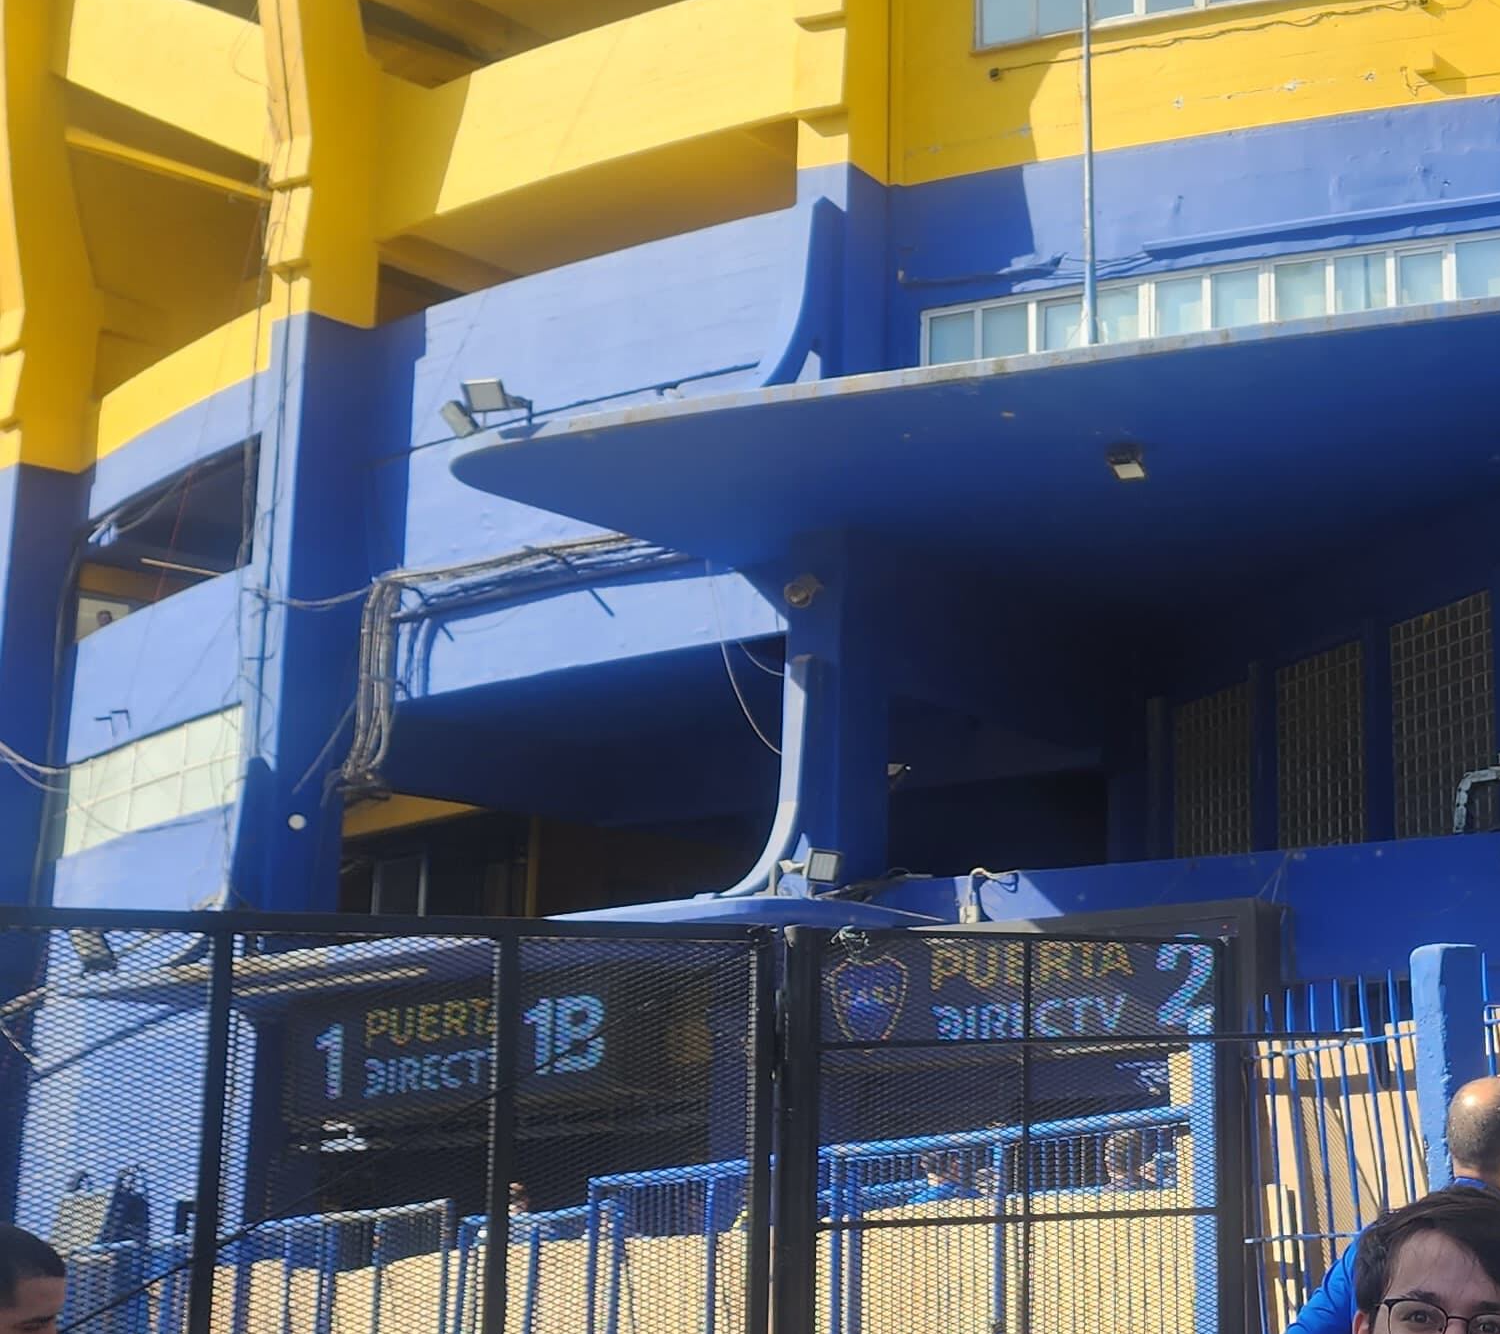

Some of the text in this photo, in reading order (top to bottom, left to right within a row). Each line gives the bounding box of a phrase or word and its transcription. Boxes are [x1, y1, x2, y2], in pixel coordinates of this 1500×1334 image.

[930, 941, 1134, 991] PUERTA
[1155, 933, 1214, 1027] 2
[365, 997, 496, 1047] PUERT
[316, 1023, 345, 1100] 1
[363, 1048, 496, 1099] DIRECT
